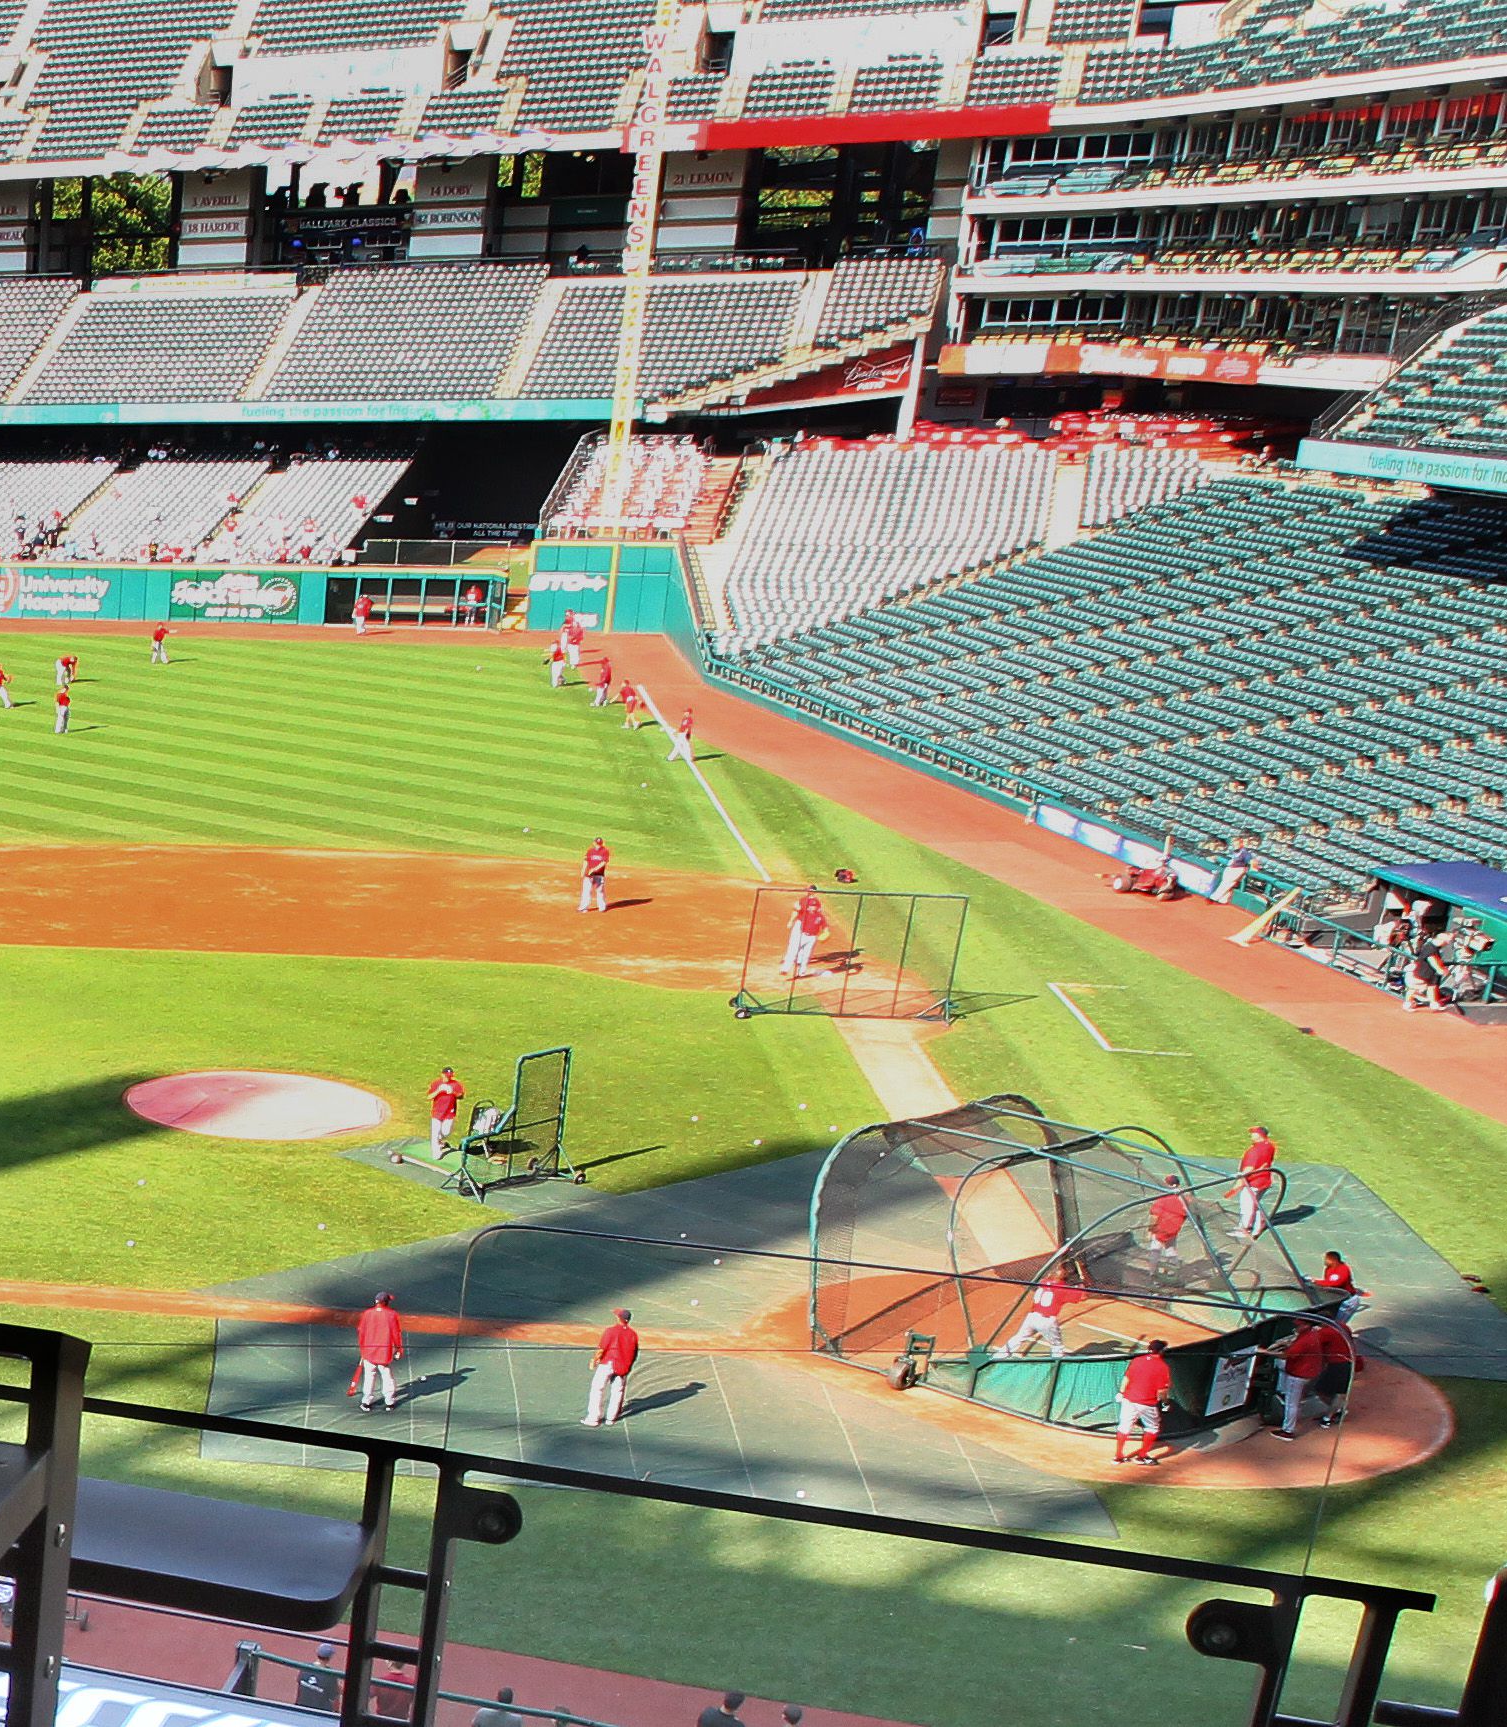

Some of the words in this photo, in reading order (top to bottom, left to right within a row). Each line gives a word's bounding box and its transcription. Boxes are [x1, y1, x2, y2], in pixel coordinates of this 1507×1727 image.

[630, 33, 667, 243] WALGREENS
[673, 175, 685, 185] 21
[689, 172, 734, 185] LEMON
[430, 186, 441, 196] 14
[443, 184, 472, 196] DOBY
[200, 195, 239, 207] AVERILL
[348, 217, 398, 228] CLASSICS
[430, 211, 482, 224] ROBINSON
[188, 223, 198, 234] 18
[199, 222, 240, 233] HARDER
[1367, 452, 1404, 476] fueling
[1406, 458, 1424, 476] the
[1426, 461, 1469, 480] passion
[1472, 463, 1489, 481] for
[20, 575, 111, 598] University
[17, 594, 102, 615] Hospitals
